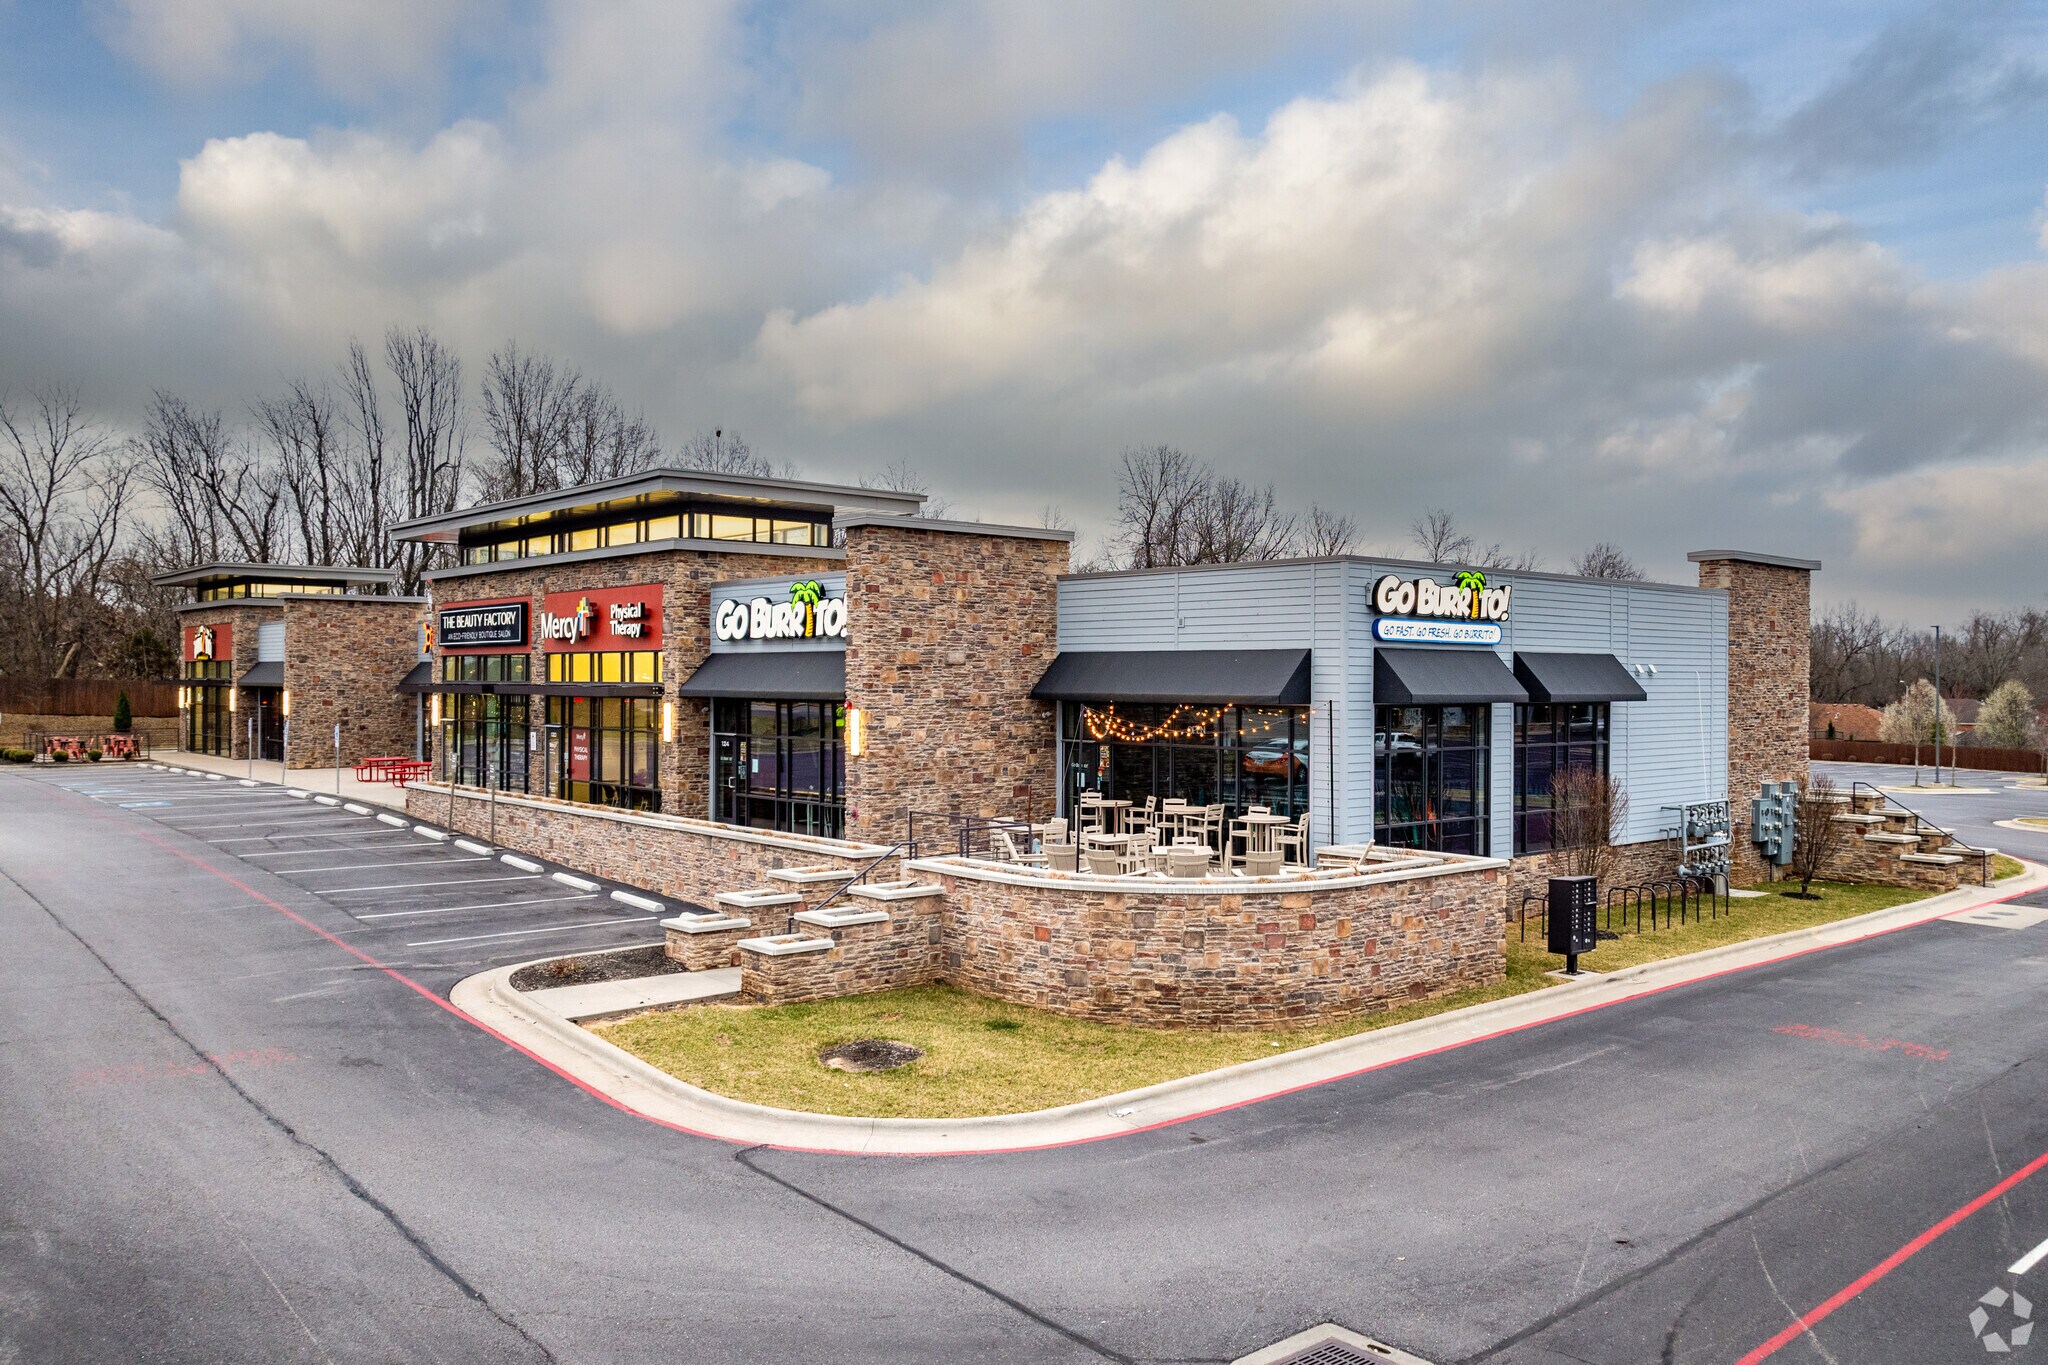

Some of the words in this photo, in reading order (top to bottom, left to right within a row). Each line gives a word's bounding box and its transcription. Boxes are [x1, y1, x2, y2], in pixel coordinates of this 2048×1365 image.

[1376, 574, 1416, 614] GO
[442, 616, 456, 629] THE
[456, 613, 483, 629] BEAUTY
[483, 611, 517, 627] FACTORY
[610, 601, 642, 621] Physical
[715, 598, 750, 642] GO
[478, 630, 497, 639] BOUTIQUE
[498, 629, 512, 638] SALON
[541, 612, 579, 644] Mercy
[609, 620, 641, 638] Therapy
[1383, 625, 1395, 635] GO
[1395, 625, 1415, 637] FAST.
[1416, 627, 1426, 637] GO
[1428, 627, 1452, 638] FRESH.
[1453, 629, 1463, 639] GO
